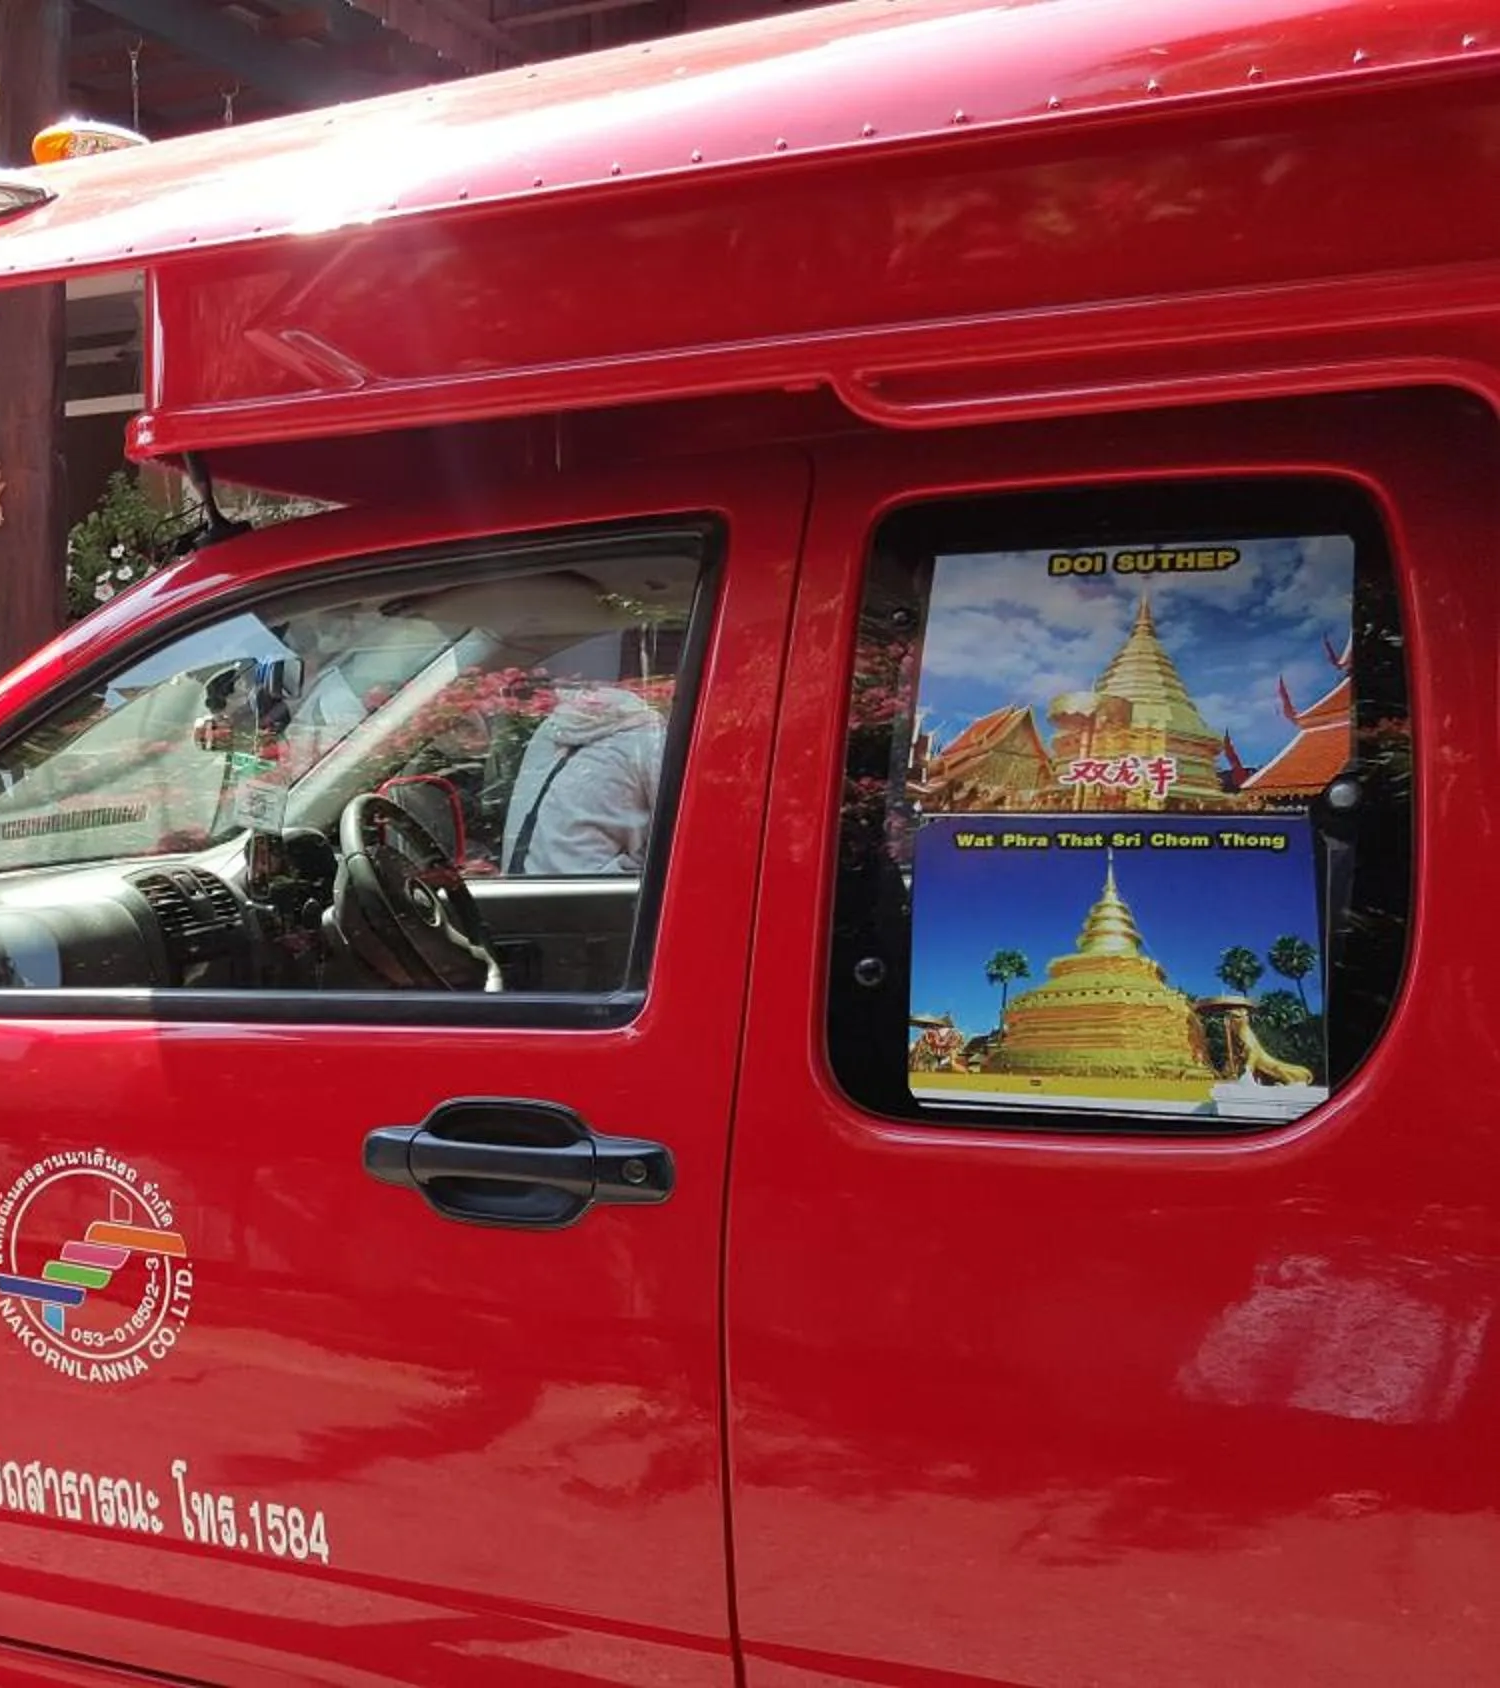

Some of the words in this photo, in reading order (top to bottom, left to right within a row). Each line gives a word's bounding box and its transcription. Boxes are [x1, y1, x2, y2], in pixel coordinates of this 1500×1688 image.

[1051, 556, 1104, 573] DOI
[1116, 551, 1237, 571] SUTHEP
[956, 834, 993, 847] Wat
[1003, 834, 1048, 847] Phra
[1058, 834, 1103, 847] That
[1112, 834, 1141, 847] Sri
[1151, 834, 1209, 847] Chom
[1219, 834, 1285, 848] Thong
